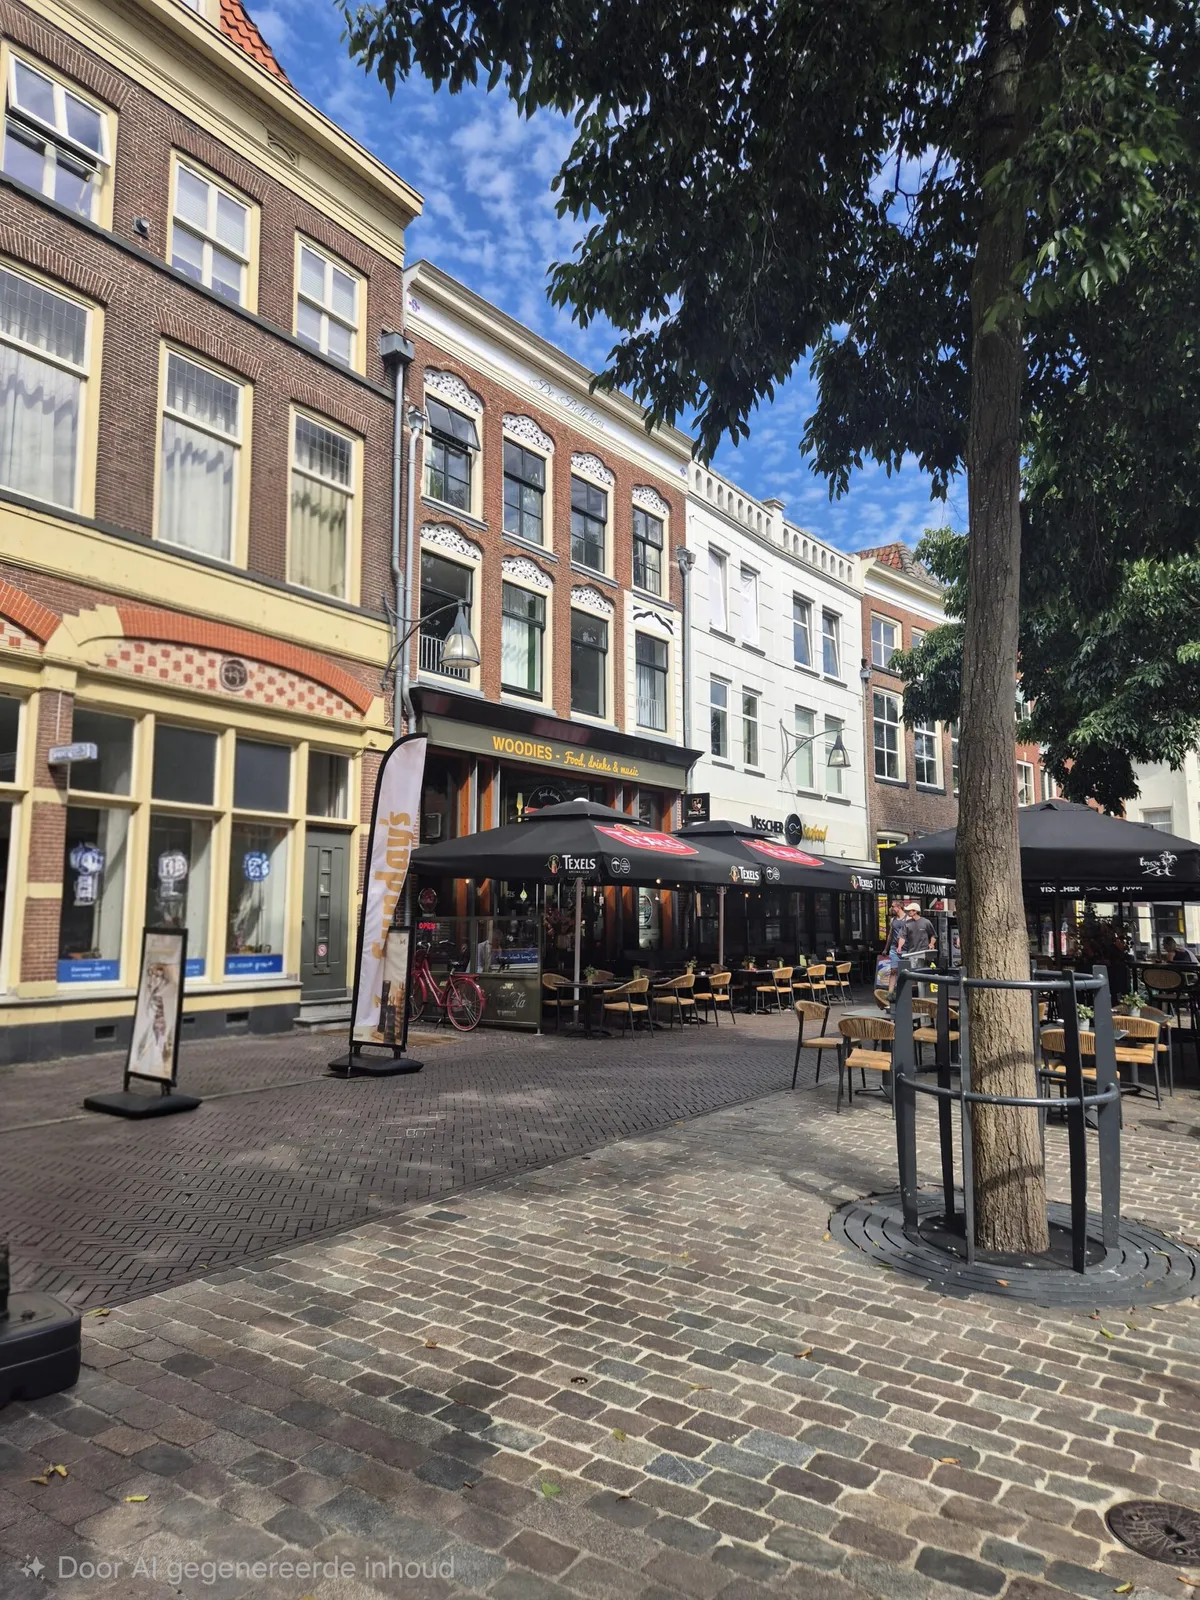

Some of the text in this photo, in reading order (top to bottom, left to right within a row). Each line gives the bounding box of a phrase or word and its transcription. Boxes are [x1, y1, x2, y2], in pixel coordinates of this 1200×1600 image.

[492, 735, 553, 761] WOODIES
[563, 750, 586, 768] Food,
[588, 755, 612, 772] drinks
[612, 761, 619, 773] &
[620, 765, 640, 777] music
[561, 854, 597, 870] TEXELS
[904, 882, 946, 896] VISRESTAURANT
